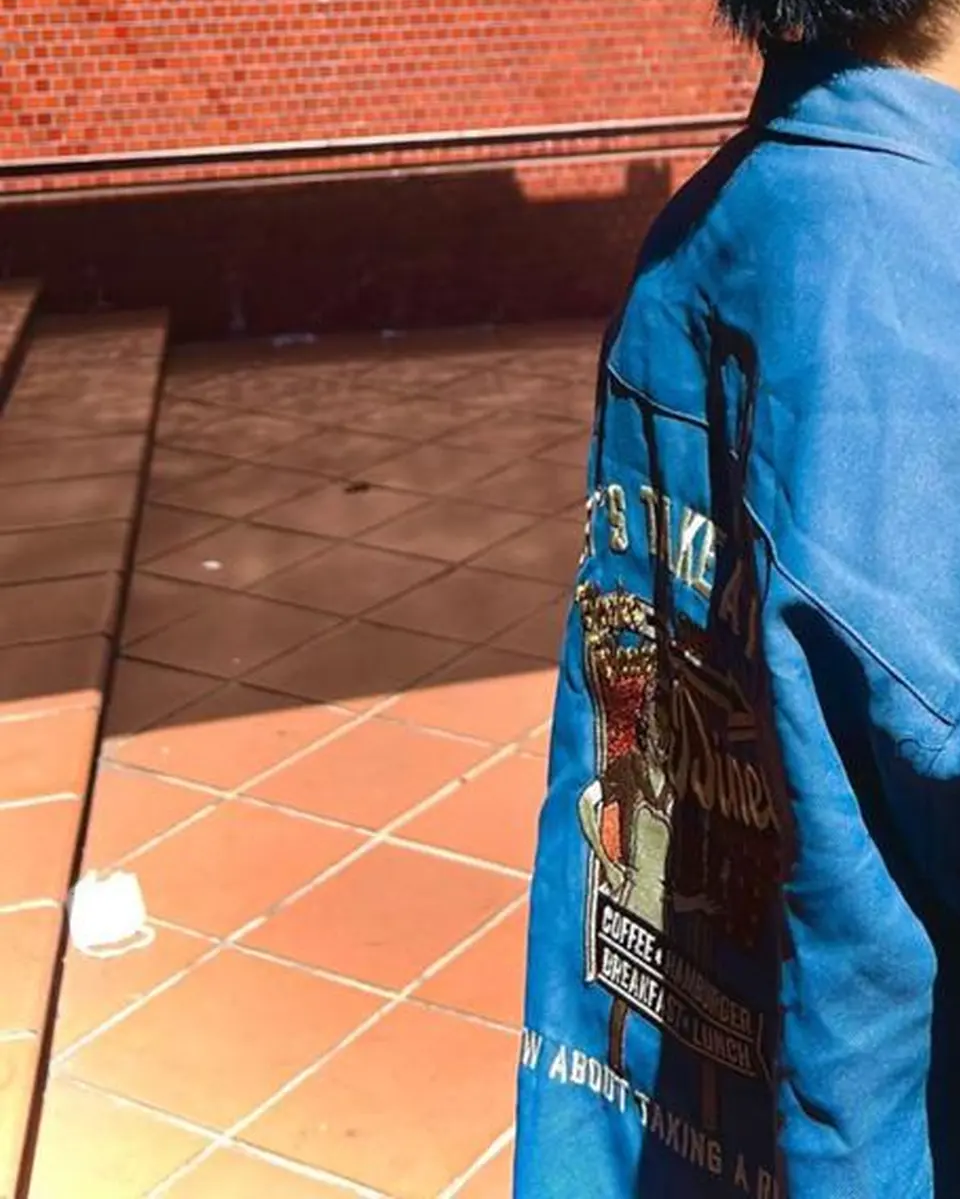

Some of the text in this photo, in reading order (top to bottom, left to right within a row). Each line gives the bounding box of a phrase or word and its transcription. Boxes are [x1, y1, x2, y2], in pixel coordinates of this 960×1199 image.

[601, 906, 657, 964] COFFEE
[601, 947, 752, 1070] BREAKFAST LUNCH
[549, 1045, 630, 1113] ABOUT
[634, 1089, 724, 1176] TAKING
[733, 1153, 750, 1191] A
